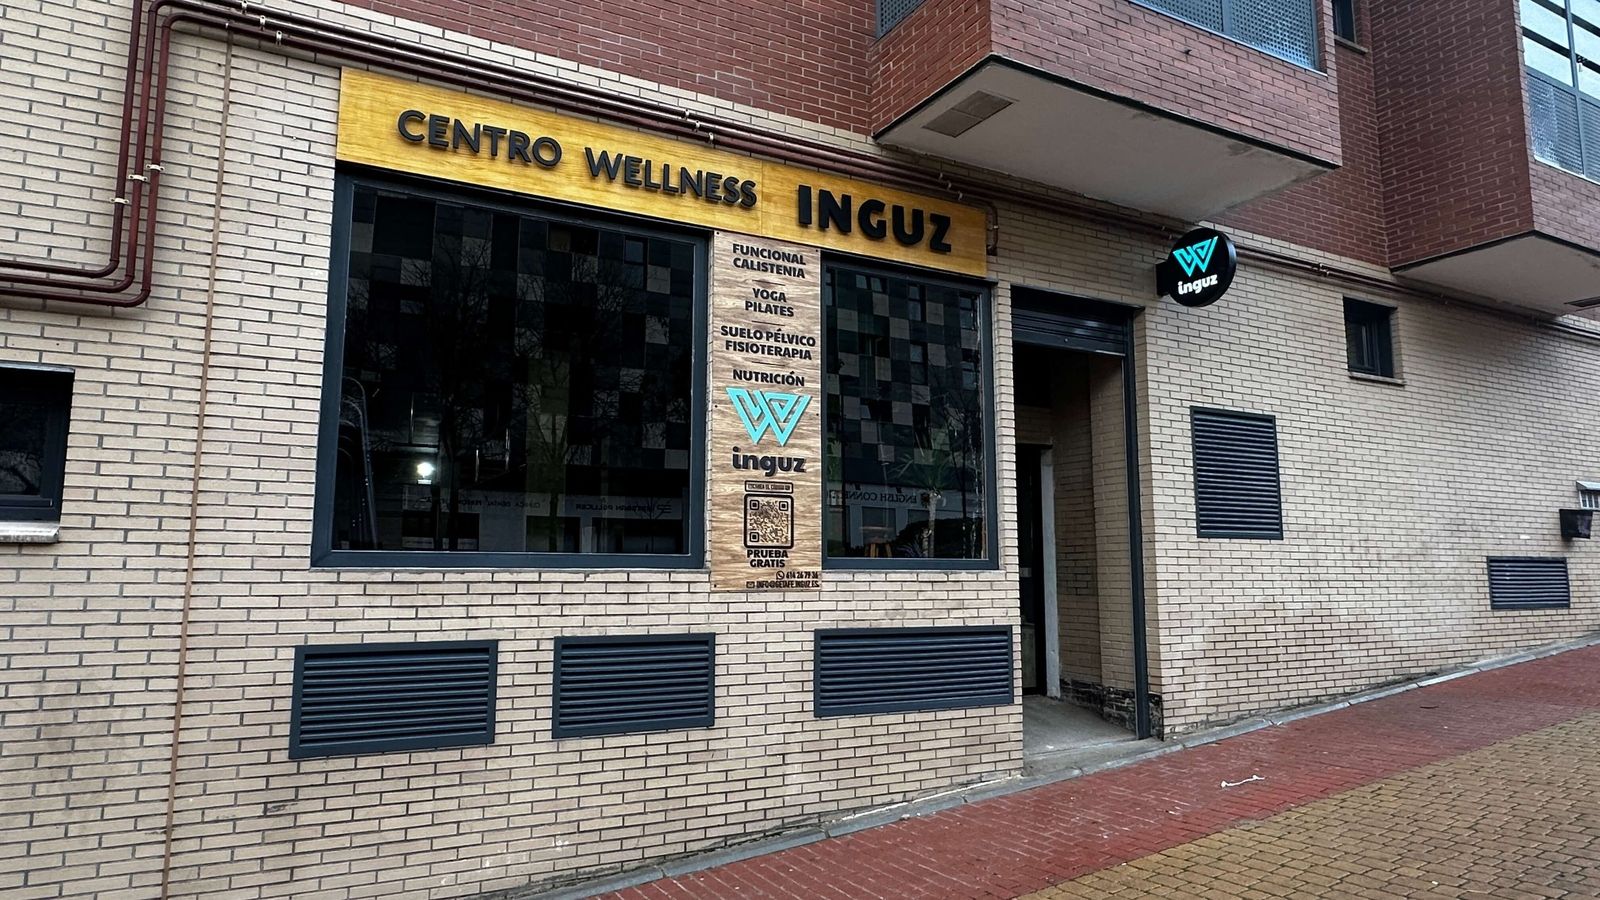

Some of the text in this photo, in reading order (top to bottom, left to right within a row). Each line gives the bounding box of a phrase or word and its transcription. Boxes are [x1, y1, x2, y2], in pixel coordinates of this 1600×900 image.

[398, 109, 953, 253] CENTRO WELLNESS INGUZ
[732, 243, 807, 266] FUNCIONAL
[733, 257, 806, 279] CALISTENIA
[752, 287, 787, 303] YOGA
[1177, 274, 1219, 295] inguz
[744, 300, 795, 318] PILATES
[720, 325, 817, 348] SUELO PÉLVICO
[725, 339, 813, 361] FISIOTERAPIA
[732, 369, 806, 387] NUTRICIÓN
[732, 446, 807, 478] inguz
[746, 549, 789, 559] PRUEBA
[749, 558, 786, 568] GRATIS
